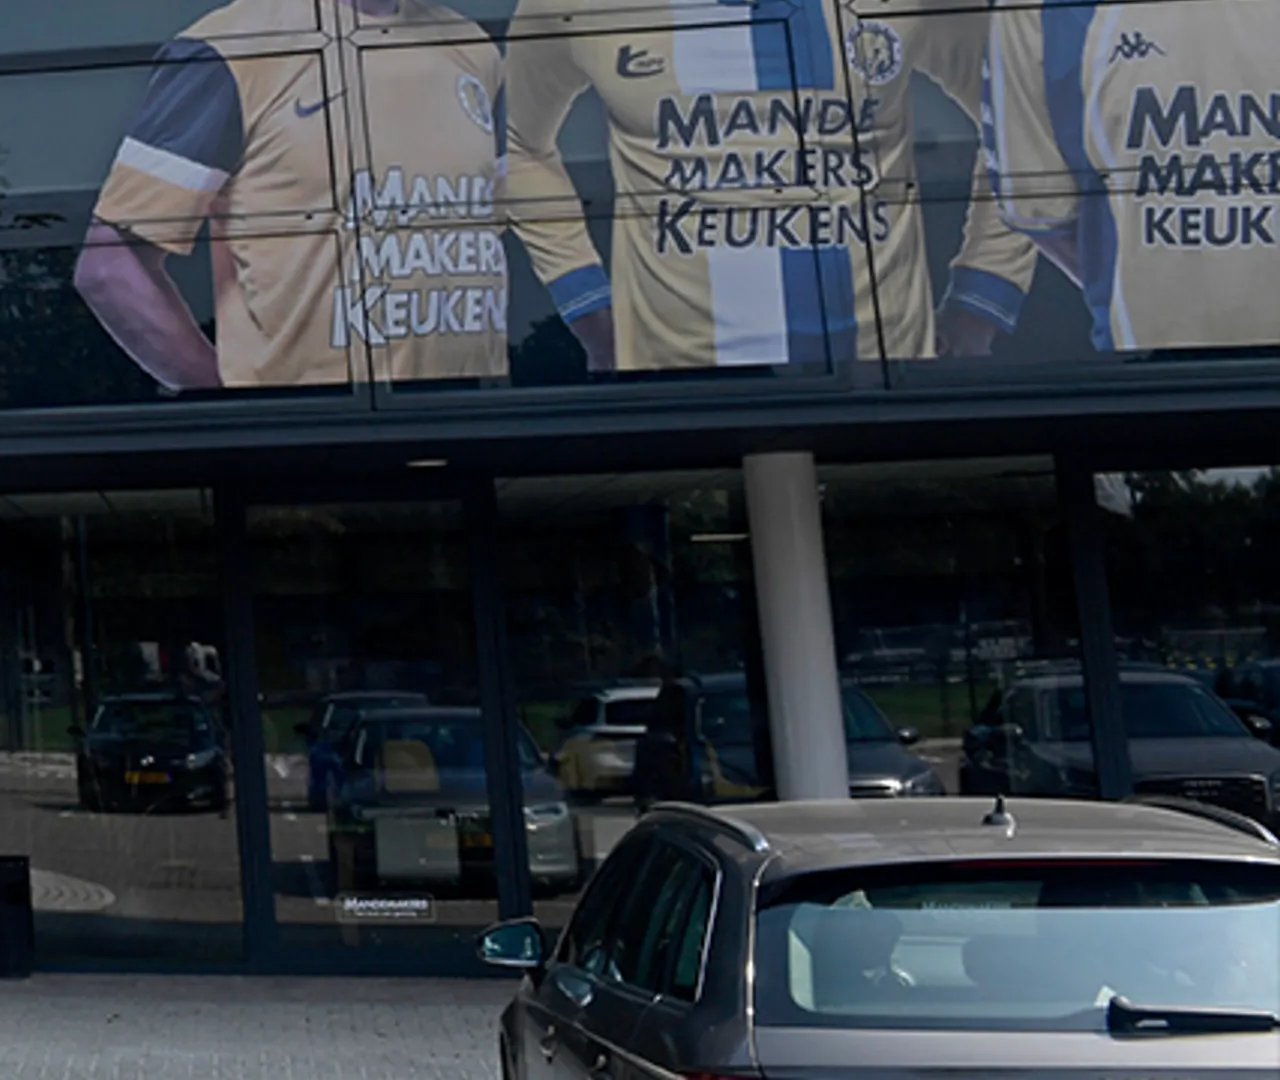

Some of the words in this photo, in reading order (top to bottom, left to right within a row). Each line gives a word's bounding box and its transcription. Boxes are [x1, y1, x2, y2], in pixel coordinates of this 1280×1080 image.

[656, 93, 880, 150] MANDE
[1126, 85, 1280, 149] MAN
[344, 166, 494, 228] MAND
[663, 148, 878, 191] MAKERS
[656, 197, 890, 254] KEUKENS
[1145, 205, 1275, 247] KEUK
[349, 231, 504, 282] MAKER
[331, 285, 506, 348] KEUKEN
